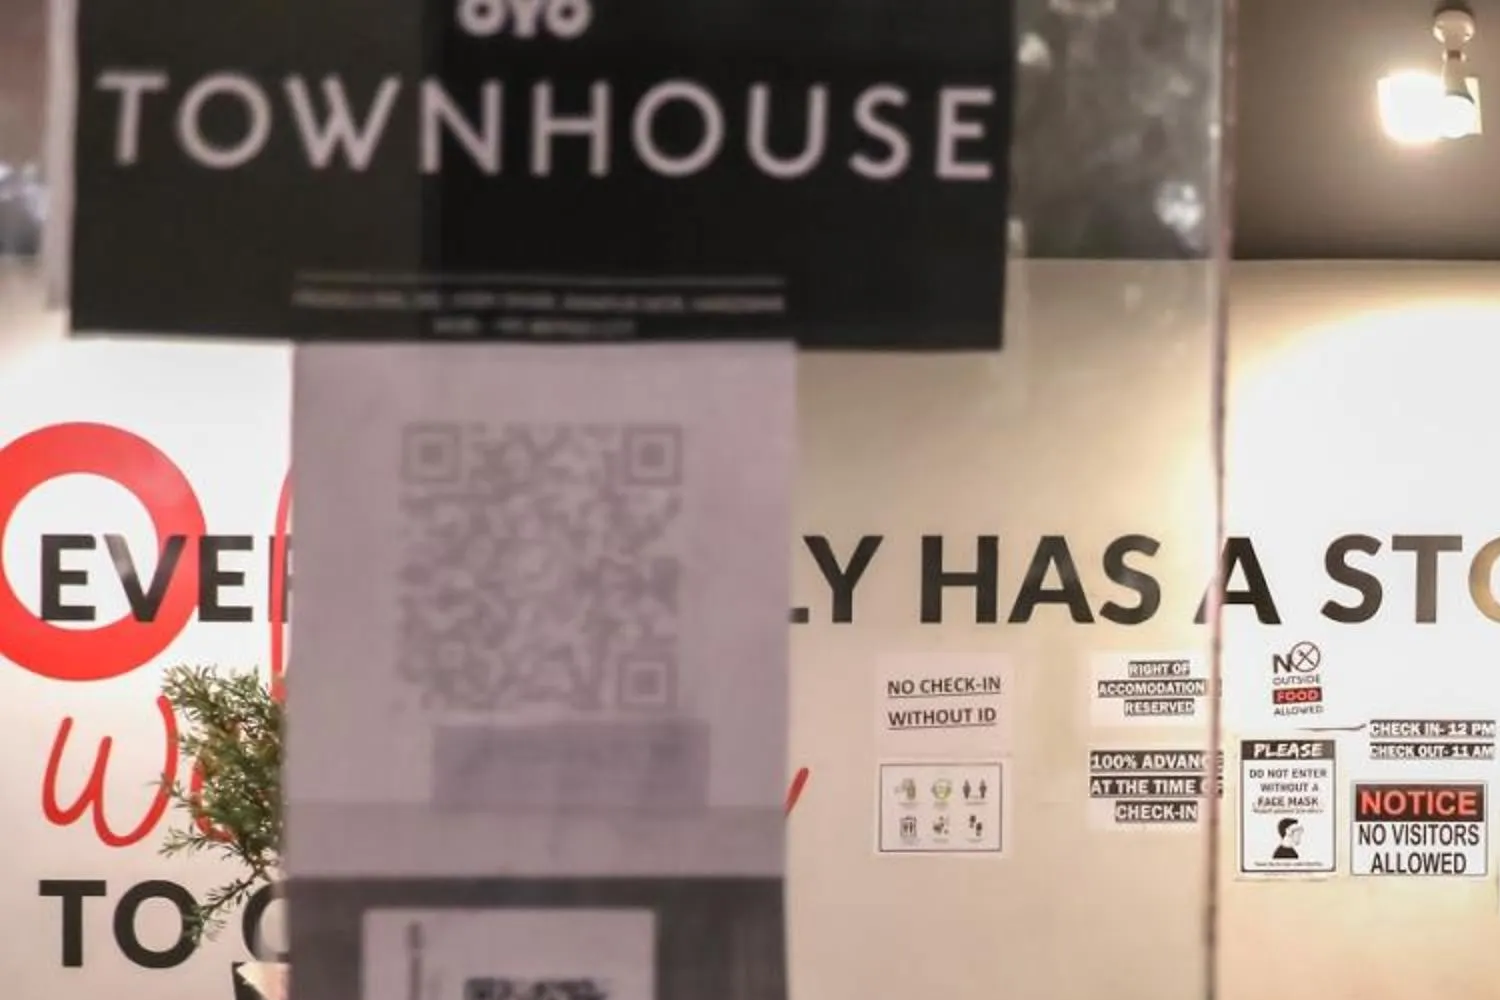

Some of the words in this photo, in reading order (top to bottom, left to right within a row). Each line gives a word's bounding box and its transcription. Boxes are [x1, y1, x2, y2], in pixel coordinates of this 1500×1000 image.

[456, 0, 593, 40] OYO
[97, 73, 995, 180] TOWNHOUSE
[789, 535, 884, 624] Y
[920, 535, 1161, 626] HAS
[1193, 537, 1282, 625] A
[1129, 662, 1169, 676] RIGHT
[1172, 662, 1190, 675] OF
[887, 679, 916, 695] NO
[919, 676, 1001, 694] CHECK-IN
[1099, 681, 1206, 696] ACCOMODATION
[1276, 689, 1319, 703] FOOD
[1124, 701, 1195, 714] RESERVED
[1273, 704, 1324, 716] ALLOWED
[888, 708, 972, 727] WITHOUT
[977, 707, 997, 723] ID
[1370, 721, 1421, 736] CHECK
[1447, 722, 1468, 735] 12
[1470, 722, 1496, 737] PM
[1253, 743, 1324, 758] PLEASE
[1369, 744, 1415, 758] CHECK
[1472, 744, 1495, 758] AM
[1091, 753, 1138, 769] 100%
[1249, 768, 1265, 779] DO
[1267, 768, 1289, 779] NOT
[1291, 768, 1328, 779] ENTER
[1091, 779, 1112, 795] AT
[1114, 779, 1149, 794] THE
[1152, 779, 1197, 794] TIME
[1259, 782, 1309, 793] WITHOUT
[1311, 782, 1319, 793] A
[1257, 796, 1285, 807] FACE
[1287, 796, 1319, 807] MASK
[1361, 789, 1478, 816] NOTICE
[1116, 804, 1199, 820] CHECK-IN
[1358, 823, 1387, 847] NO
[1391, 823, 1480, 847] VISITORS
[1370, 851, 1467, 875] ALLOWED
[39, 880, 202, 968] TO
